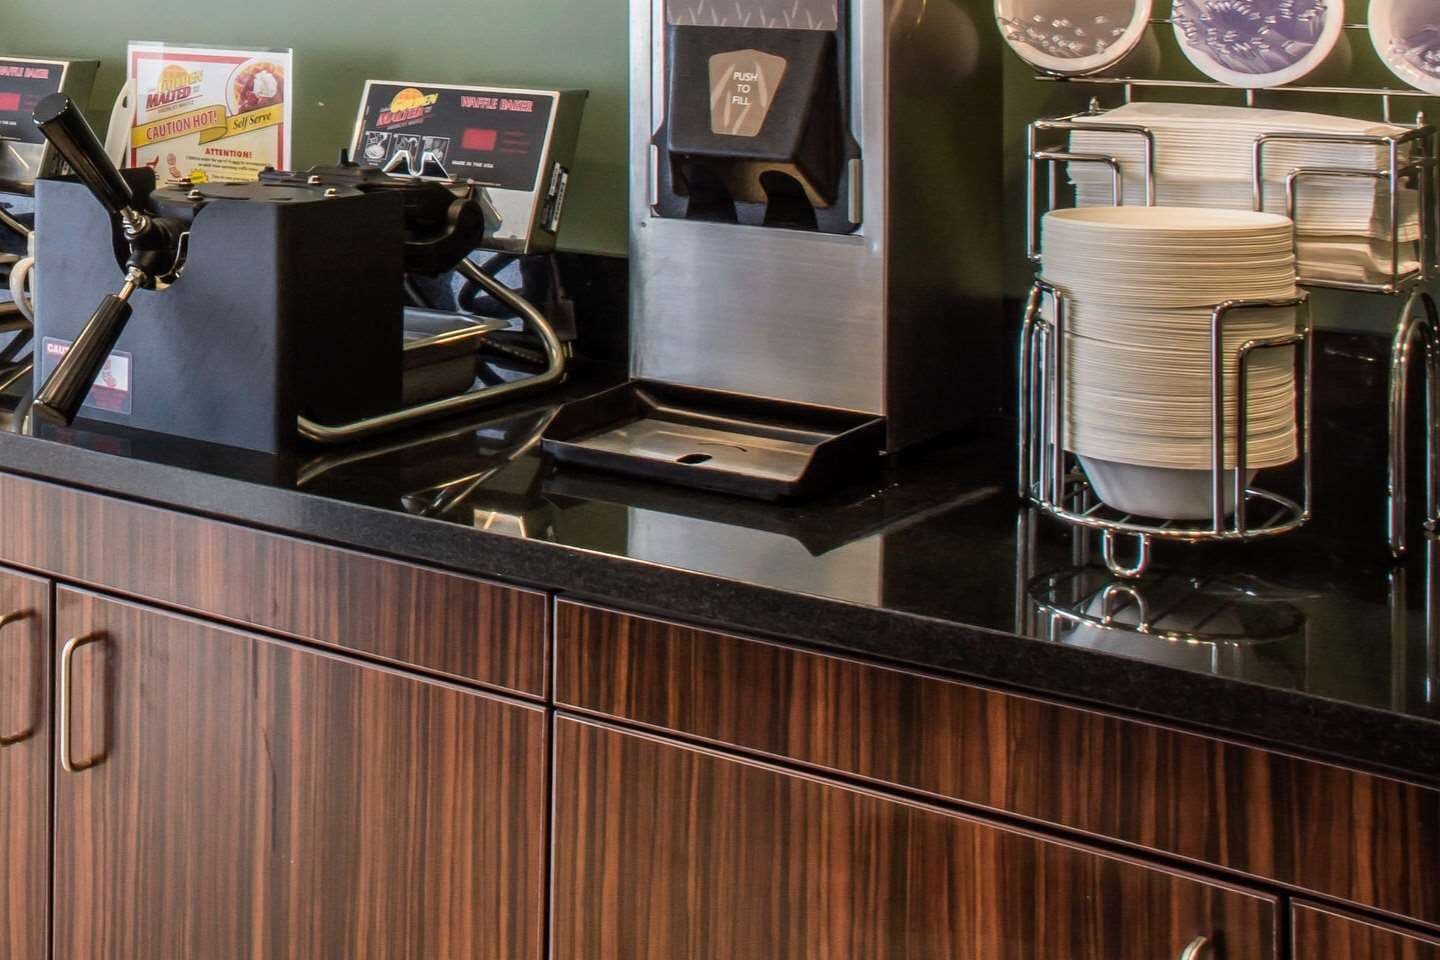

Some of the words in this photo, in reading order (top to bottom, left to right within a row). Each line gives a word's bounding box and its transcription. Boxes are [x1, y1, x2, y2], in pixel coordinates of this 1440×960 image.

[733, 71, 758, 81] PUSH
[736, 84, 750, 93] TO
[146, 86, 192, 109] MALTED
[461, 96, 498, 109] WAFFLE
[499, 99, 533, 112] BAKER
[732, 96, 752, 105] FILL
[146, 117, 192, 140] CAUTION
[193, 110, 218, 128] HOT!
[233, 117, 249, 130] Self
[249, 111, 272, 127] Serve
[205, 147, 252, 159] ATTENTION!
